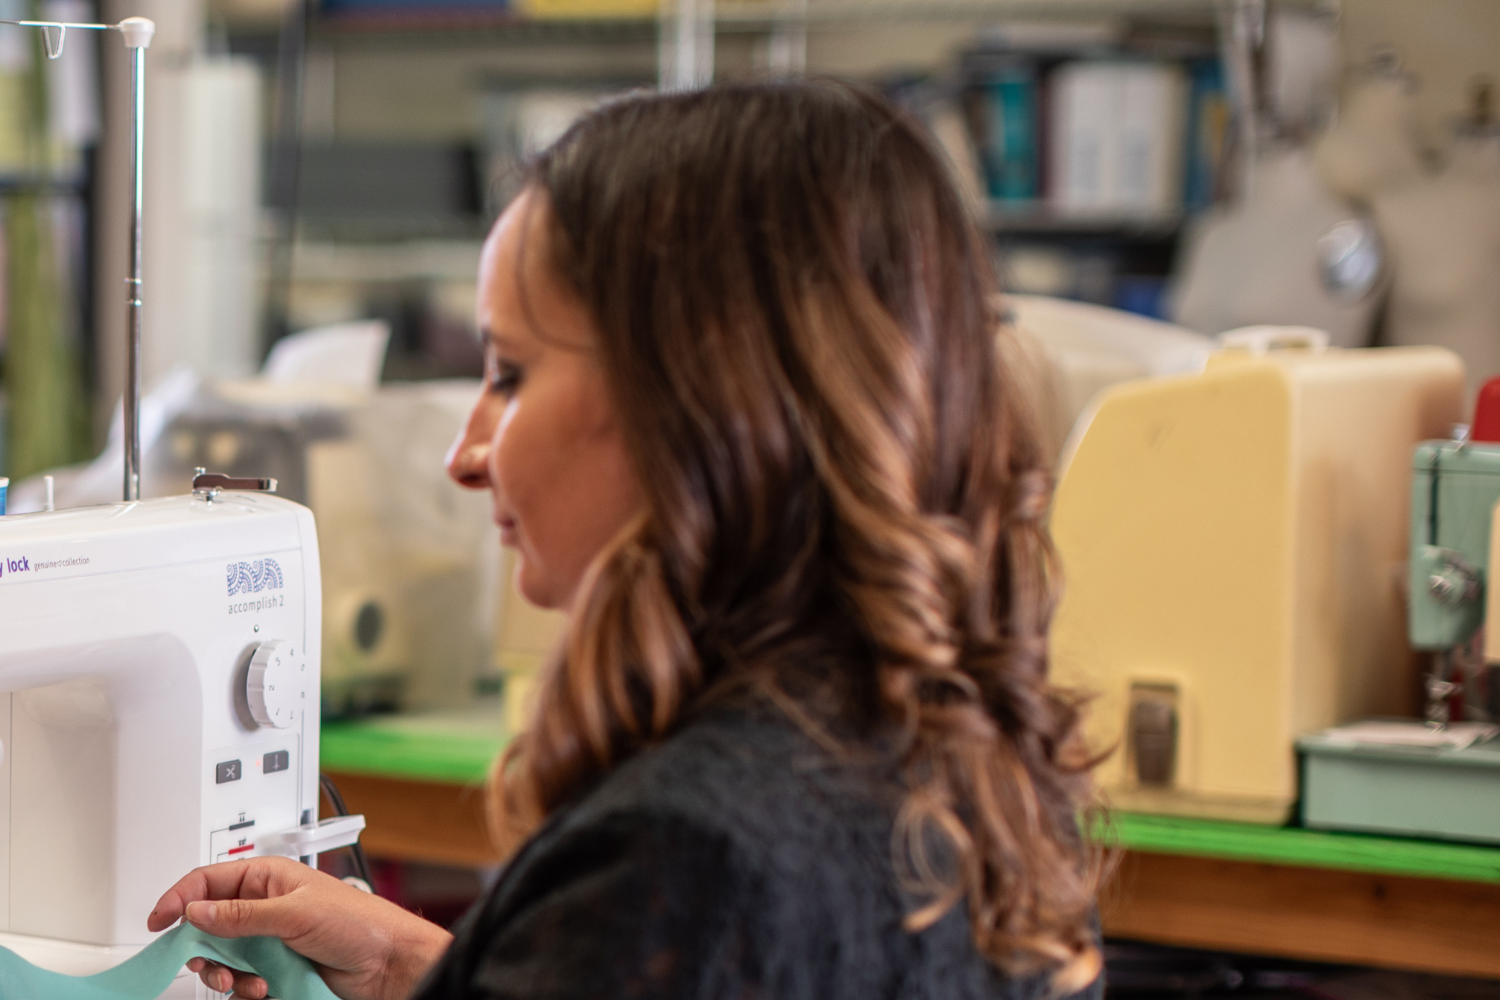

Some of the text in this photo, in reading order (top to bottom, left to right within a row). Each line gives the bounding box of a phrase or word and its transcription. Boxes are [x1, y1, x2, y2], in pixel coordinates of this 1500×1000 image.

[7, 556, 30, 573] lock
[228, 594, 284, 614] accomplish 2
